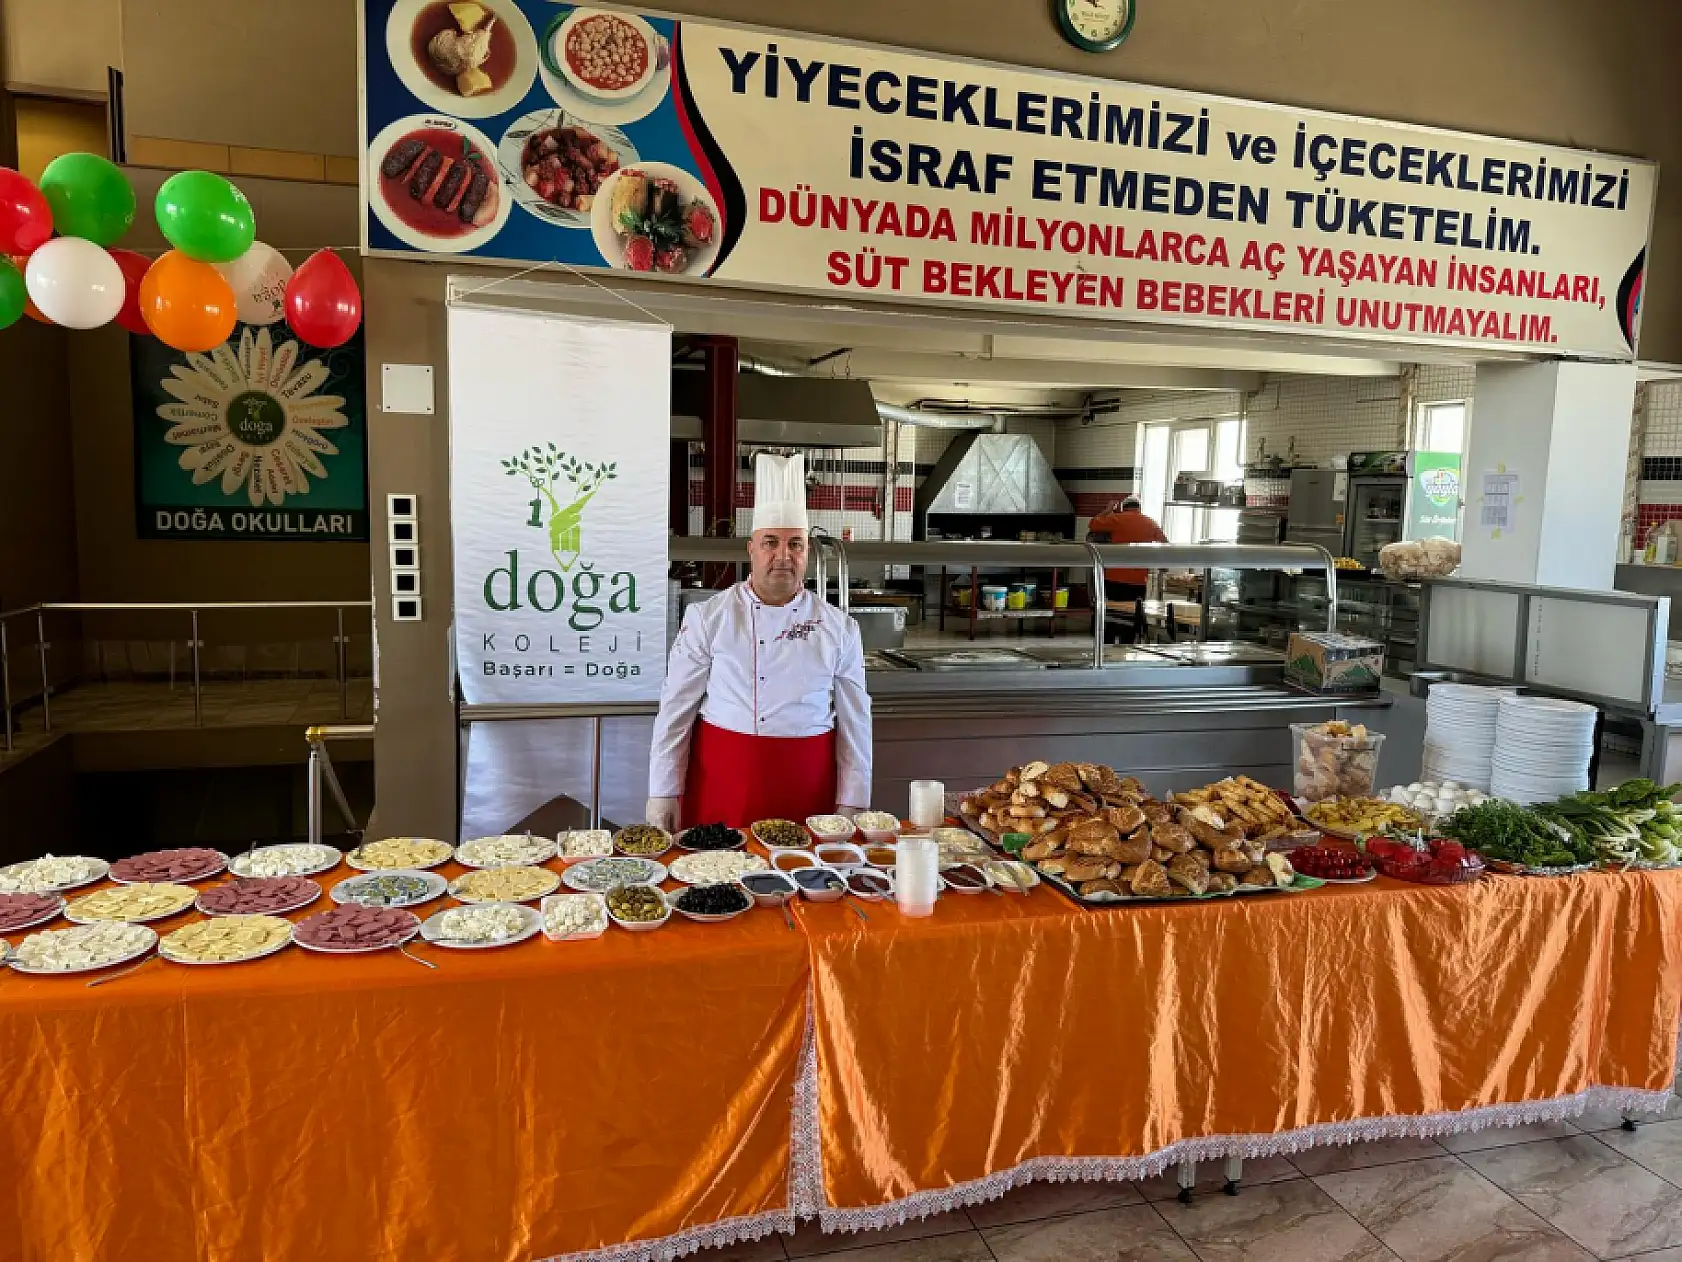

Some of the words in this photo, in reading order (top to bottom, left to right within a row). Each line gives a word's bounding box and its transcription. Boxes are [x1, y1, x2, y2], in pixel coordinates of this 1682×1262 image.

[719, 44, 1209, 155] YİYECEKLERİMİZİ
[1227, 131, 1276, 164] ve
[1294, 122, 1630, 211] İÇECEKLERİMİZİ
[849, 126, 1013, 194] İSRAF
[1032, 159, 1268, 224] ETMEDEN
[1286, 188, 1541, 255] TÜKETELİM.
[758, 184, 957, 242] DÜNYADA
[970, 206, 1229, 268] MİLYONLARCA
[1240, 240, 1286, 281] AÇ
[1297, 246, 1437, 288] YAŞAYAN
[1447, 255, 1607, 311] İNSANLARI,
[826, 247, 909, 291] SÜT
[923, 261, 1124, 308] BEKLEYEN
[1136, 279, 1325, 326] BEBEKLERİ
[1336, 297, 1558, 343] UNUTMAYALIM.
[156, 508, 225, 531] DOĞA
[231, 512, 353, 534] OKULLARI
[483, 548, 641, 632] doğa
[483, 661, 553, 679] Başarı
[586, 661, 641, 680] Doğa
